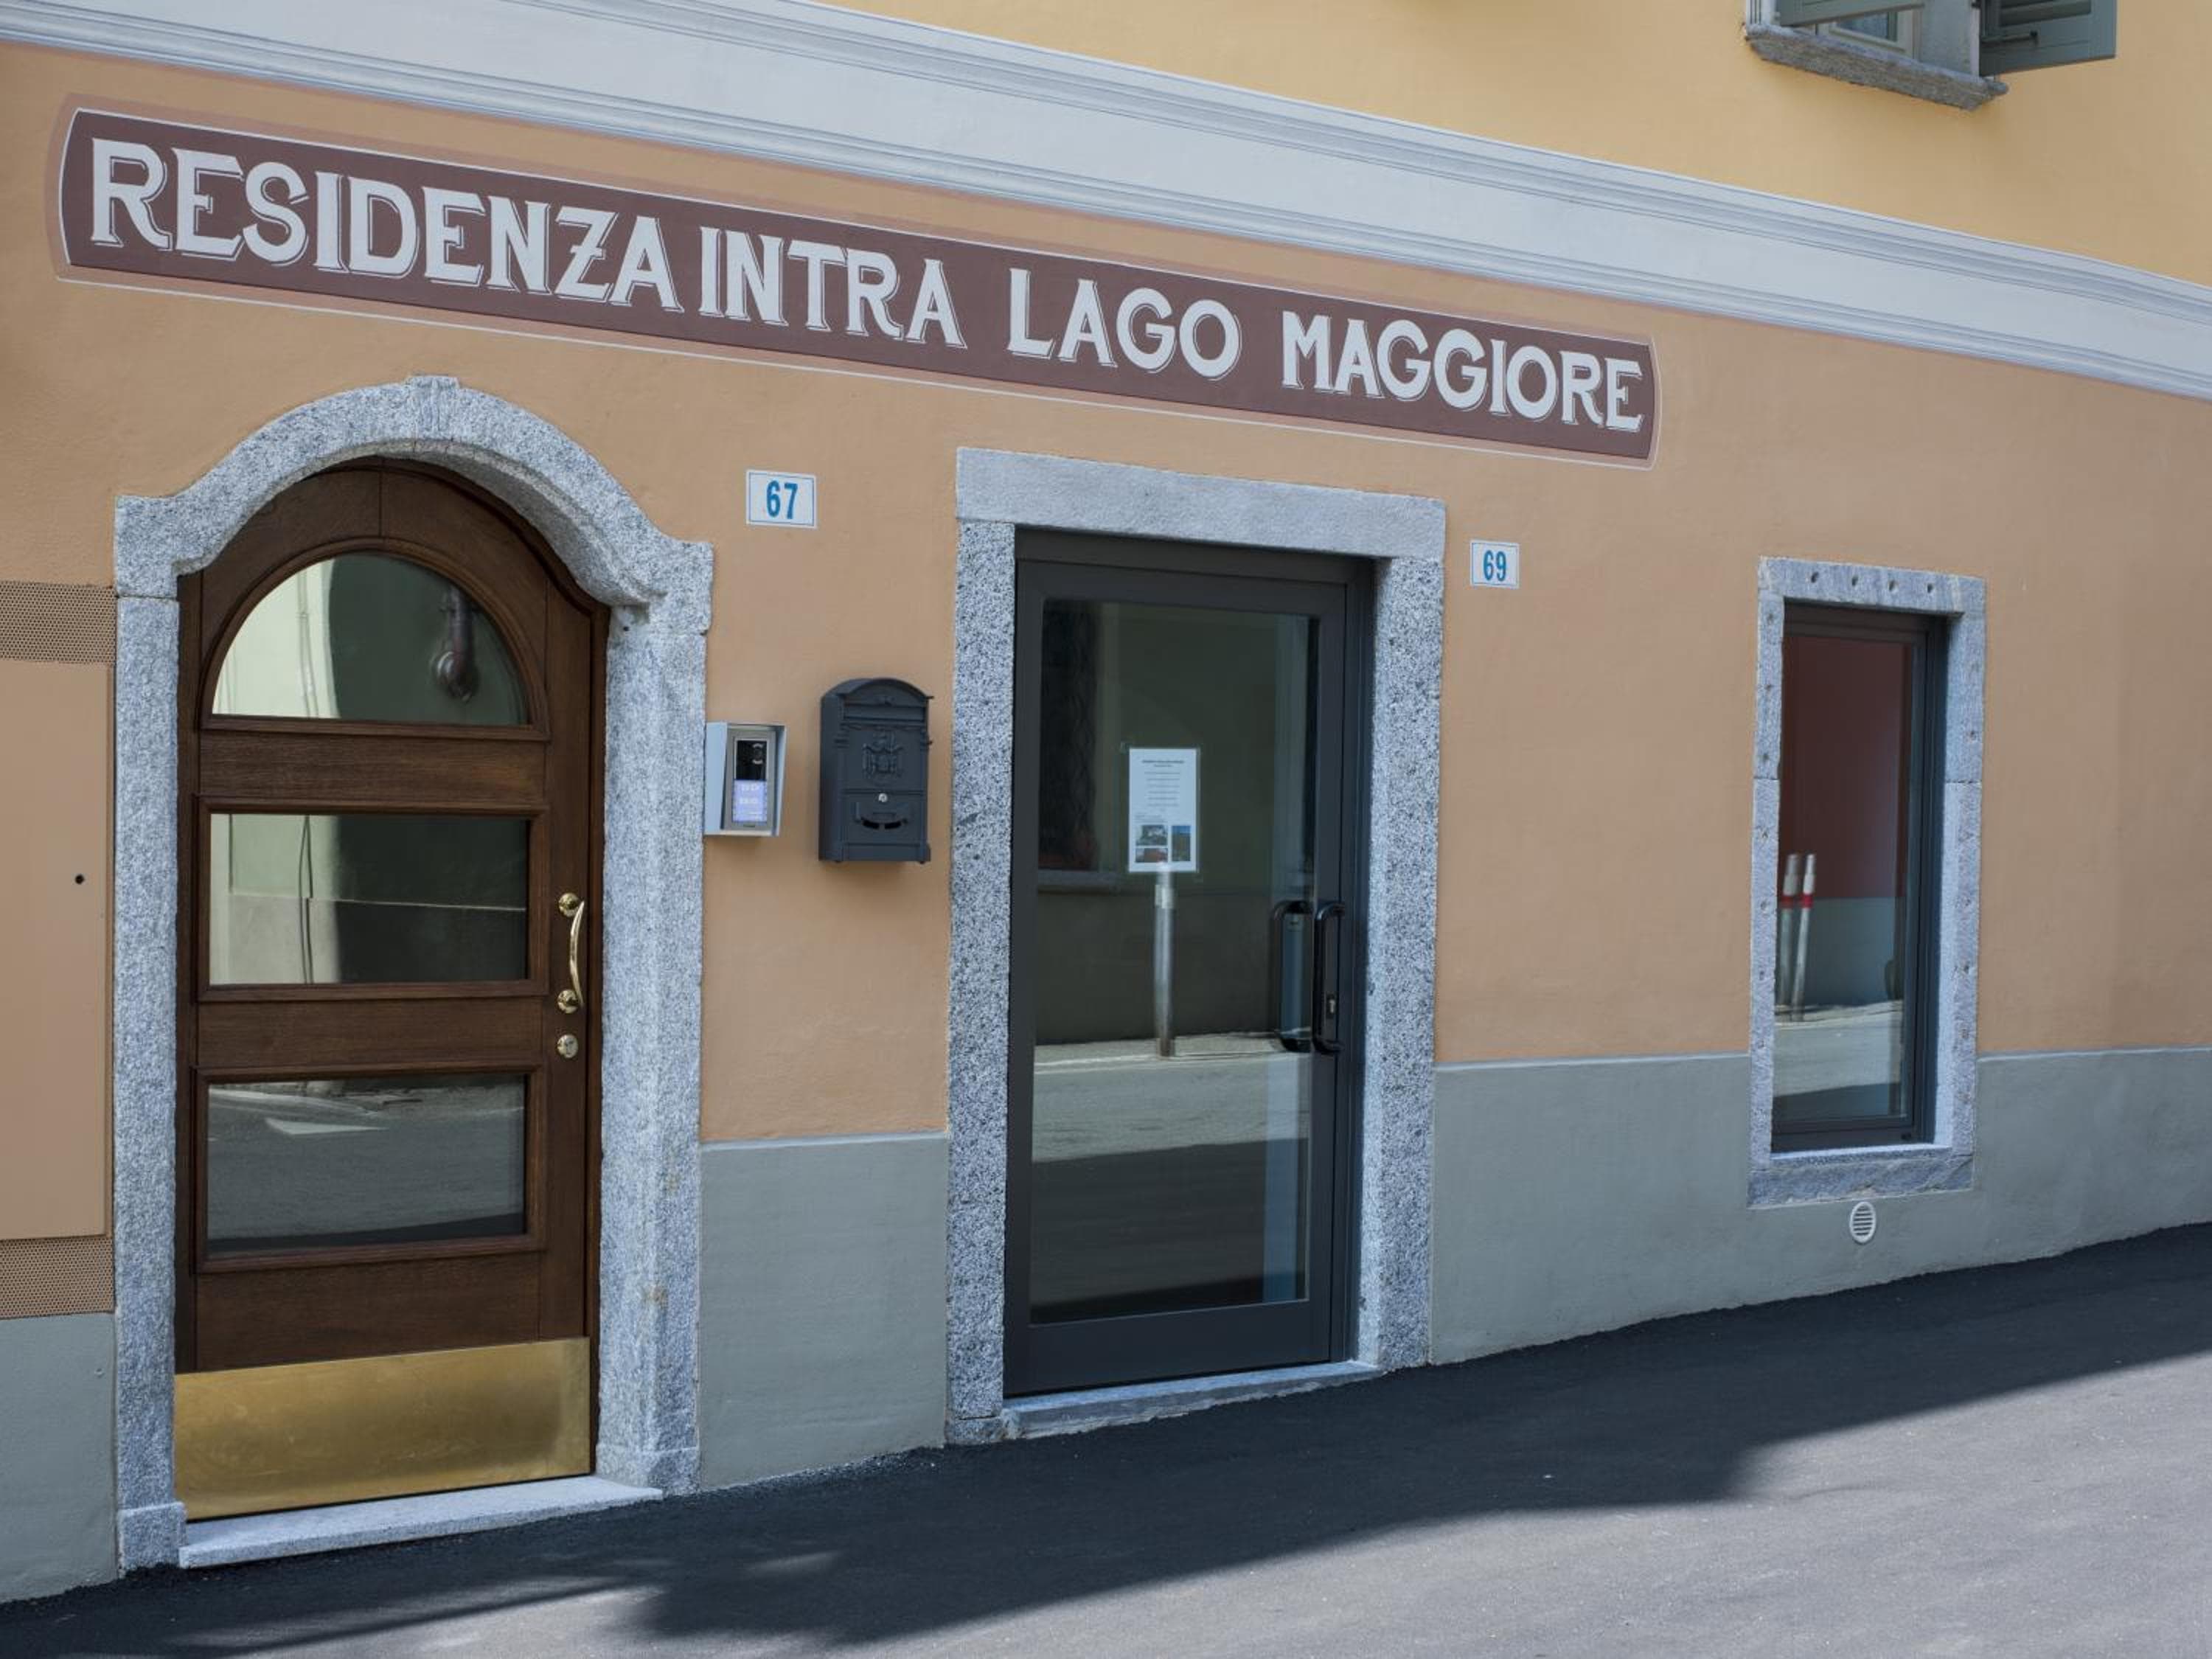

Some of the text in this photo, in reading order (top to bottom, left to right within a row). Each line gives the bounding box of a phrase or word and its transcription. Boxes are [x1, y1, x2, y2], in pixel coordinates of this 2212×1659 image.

[91, 138, 1644, 433] RESIDENZA INTRA LAGO MAGGIORE
[767, 480, 798, 520] 67
[1483, 550, 1506, 582] 69
